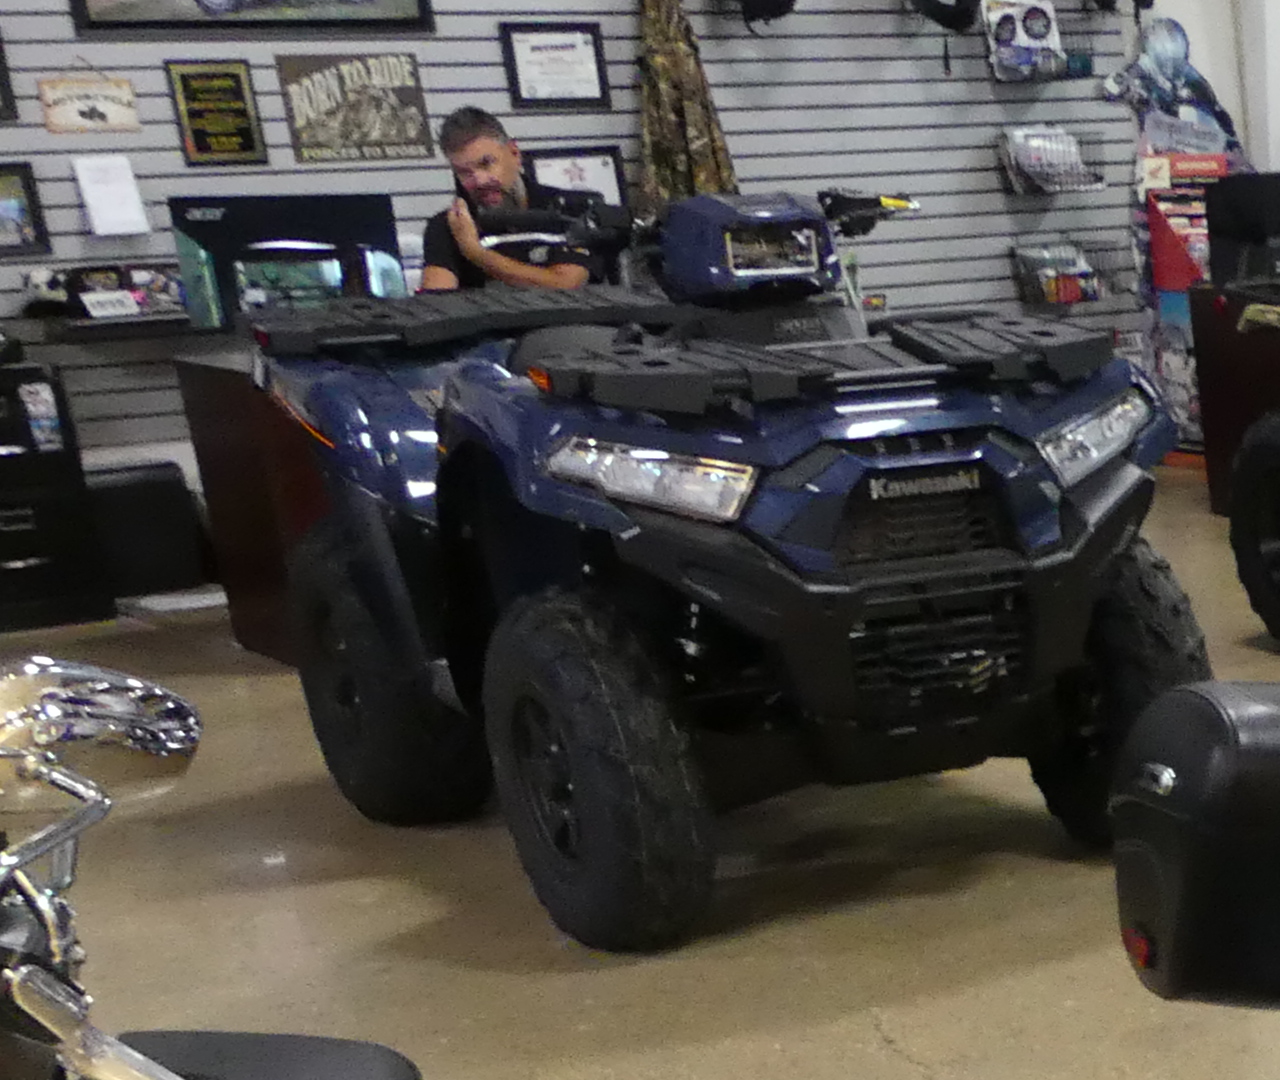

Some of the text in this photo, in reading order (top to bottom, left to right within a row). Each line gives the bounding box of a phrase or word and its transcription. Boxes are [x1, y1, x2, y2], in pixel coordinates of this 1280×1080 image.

[287, 55, 416, 128] BORN TO RIDE
[869, 468, 980, 499] Kawasaki
